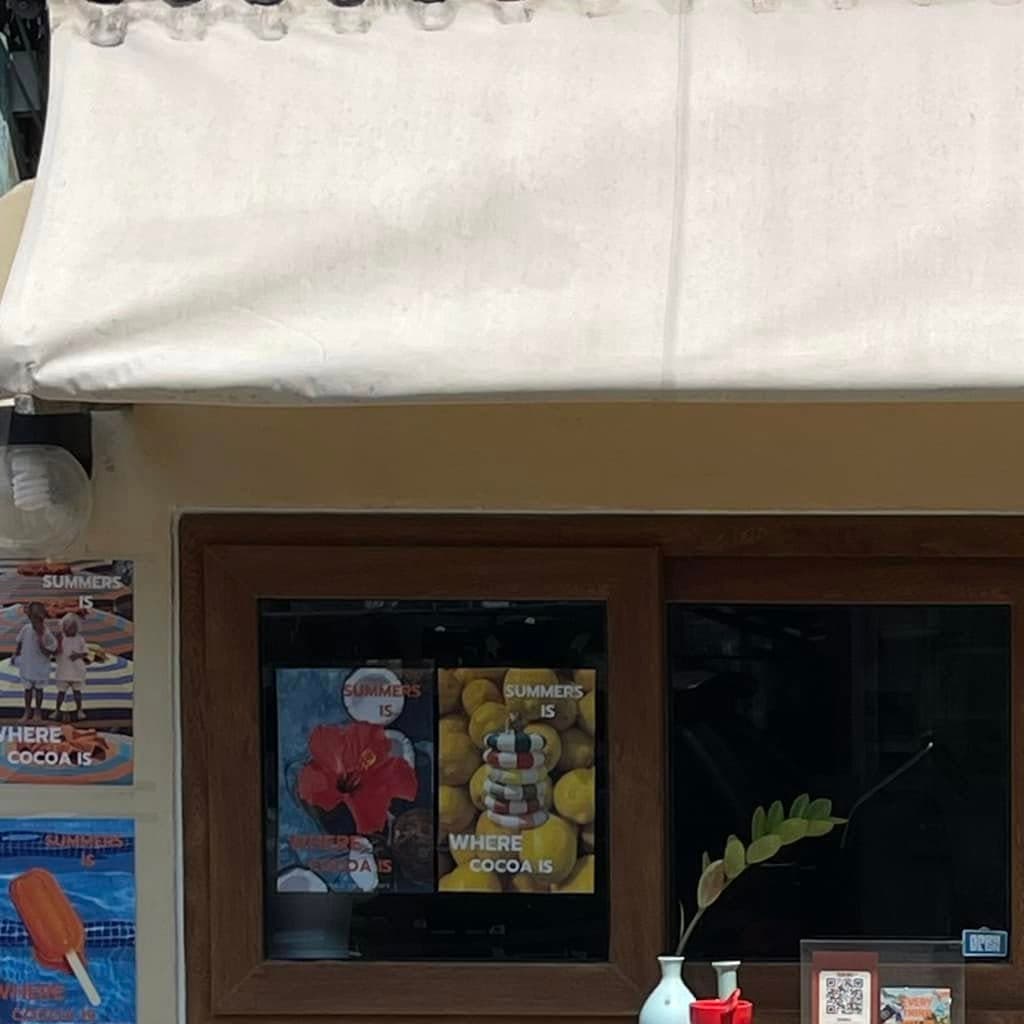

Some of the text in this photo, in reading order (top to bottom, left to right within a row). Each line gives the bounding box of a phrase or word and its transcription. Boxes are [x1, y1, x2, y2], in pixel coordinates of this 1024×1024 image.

[42, 575, 122, 589] SUMMERS
[79, 596, 93, 609] IS
[343, 684, 421, 698] SUMMERS
[504, 685, 583, 698] SUMMERS
[379, 704, 392, 717] IS
[541, 705, 555, 718] IS
[7, 751, 92, 766] COCOA IS
[44, 834, 124, 849] SUMMERS
[289, 835, 361, 849] WHERE
[449, 834, 522, 850] WHERE
[378, 859, 392, 873] IS
[470, 859, 553, 873] COCOA IS
[969, 934, 1001, 952] OPEN
